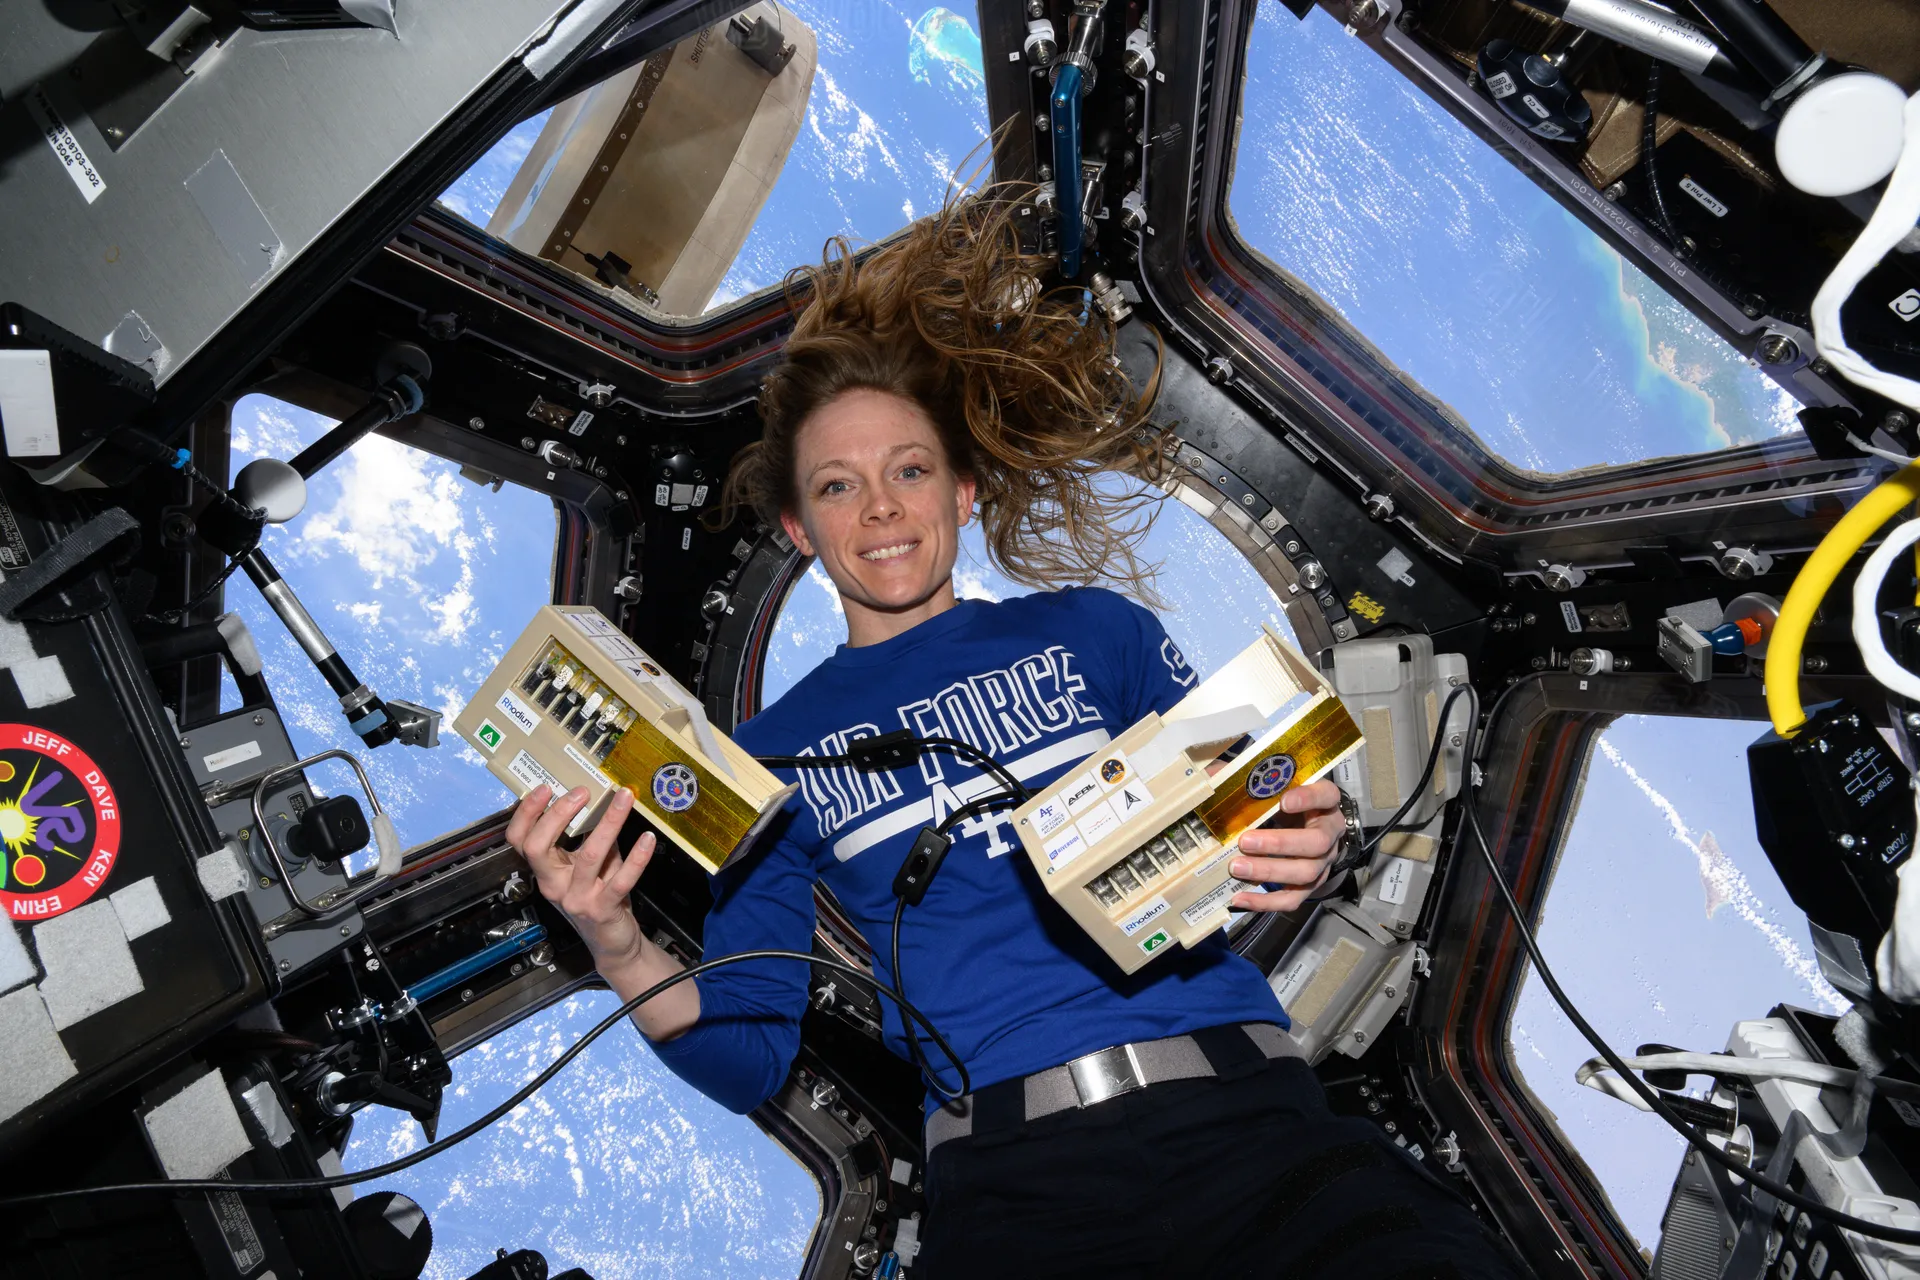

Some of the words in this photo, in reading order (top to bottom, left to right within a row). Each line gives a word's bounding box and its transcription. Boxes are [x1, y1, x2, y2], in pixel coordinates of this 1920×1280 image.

[689, 27, 710, 63] SHUTTER
[56, 142, 74, 166] 5045
[1689, 186, 1703, 198] Pnl
[10, 530, 24, 554] PANEL
[1357, 597, 1377, 612] VACUUM
[500, 696, 534, 729] Rhodium
[22, 731, 71, 757] JEFF
[796, 722, 904, 838] AIR
[897, 645, 1102, 786] FORCE
[1861, 745, 1875, 758] CORD
[518, 756, 528, 767] P/N
[522, 752, 542, 772] Rhodium
[540, 769, 557, 785] Sophia
[565, 746, 583, 763] Rhodium
[581, 760, 596, 775] USAFA
[594, 772, 607, 785] NIGHT
[512, 765, 521, 775] S/N
[519, 772, 531, 784] 0002
[1873, 772, 1895, 792] STRIP
[84, 771, 116, 821] DAVE
[1066, 781, 1096, 806] AFRL
[1855, 787, 1876, 806] GAGE
[1036, 802, 1056, 820] AF
[1057, 835, 1079, 853] RIVERSIDE
[83, 848, 112, 887] KEN
[13, 894, 62, 915] ERIN
[1125, 902, 1164, 932] Rhodium
[1278, 979, 1290, 995] Vacuum
[1287, 972, 1296, 981] Line
[1293, 962, 1303, 974] Cover
